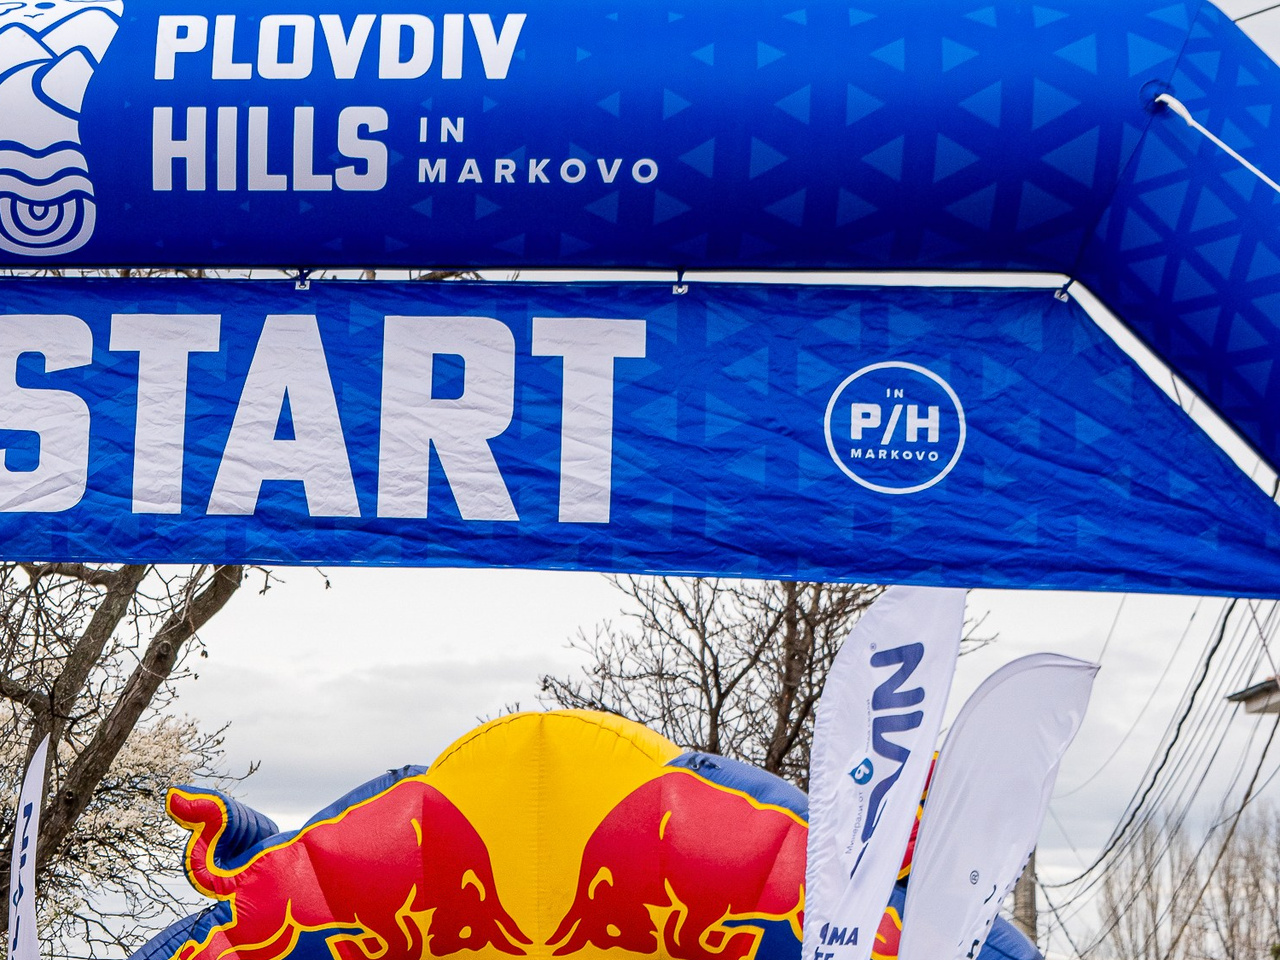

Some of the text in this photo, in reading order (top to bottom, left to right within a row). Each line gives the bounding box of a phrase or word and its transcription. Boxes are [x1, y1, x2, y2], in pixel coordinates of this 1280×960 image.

[154, 14, 527, 80] PLOVDIV
[419, 117, 465, 143] IN
[152, 106, 389, 191] HILLS
[417, 157, 659, 184] MARKOVO
[886, 388, 904, 399] IN
[850, 402, 940, 445] P/H
[850, 448, 939, 461] MARKOVO
